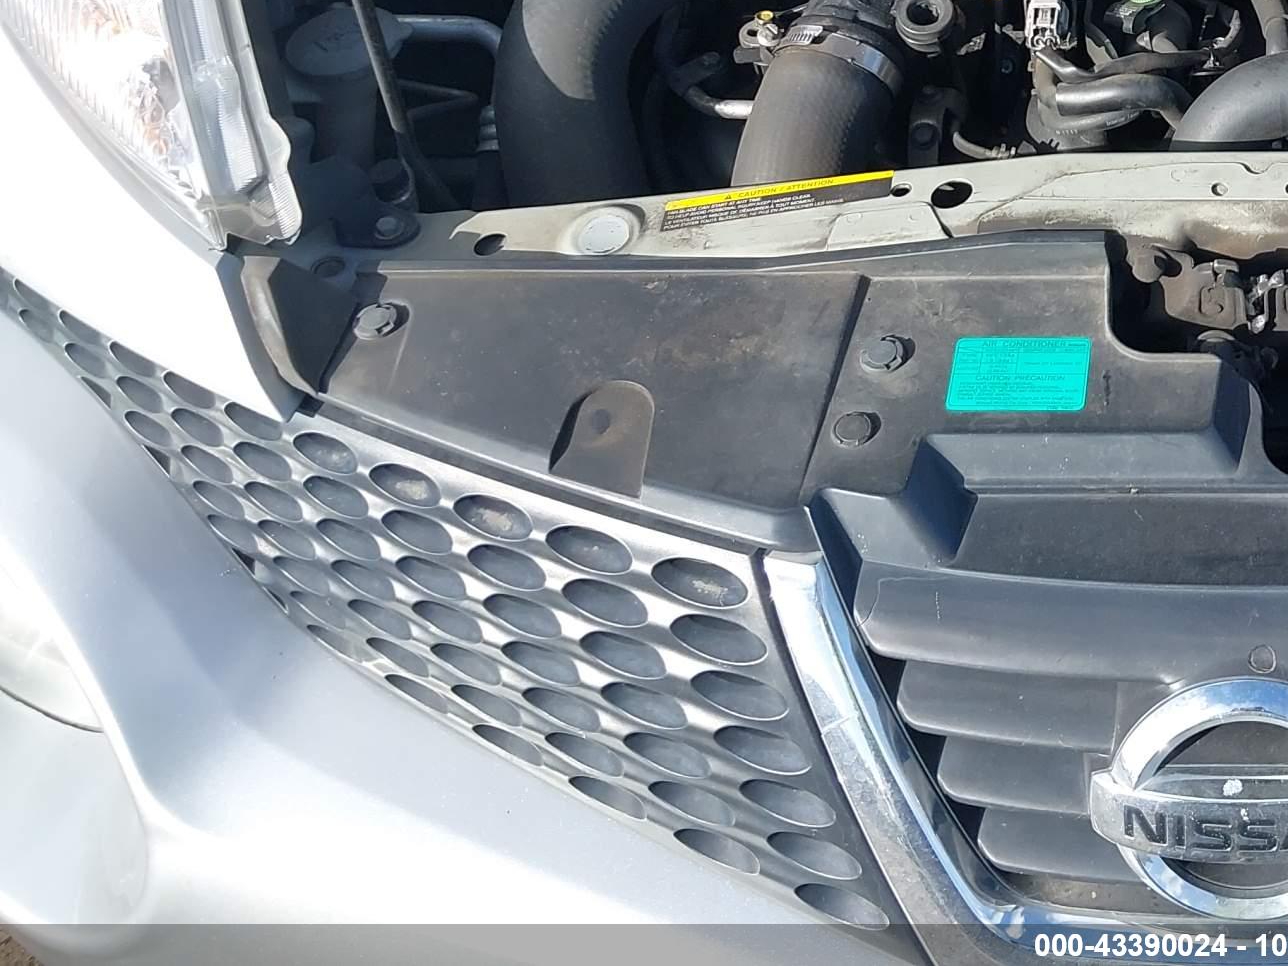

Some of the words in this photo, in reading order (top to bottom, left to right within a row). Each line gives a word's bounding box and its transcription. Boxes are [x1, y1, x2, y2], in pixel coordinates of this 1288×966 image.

[738, 188, 777, 198] CAUTION
[786, 179, 834, 191] ATTENTION
[982, 339, 999, 347] AIR
[1003, 339, 1066, 347] CONDITIONER
